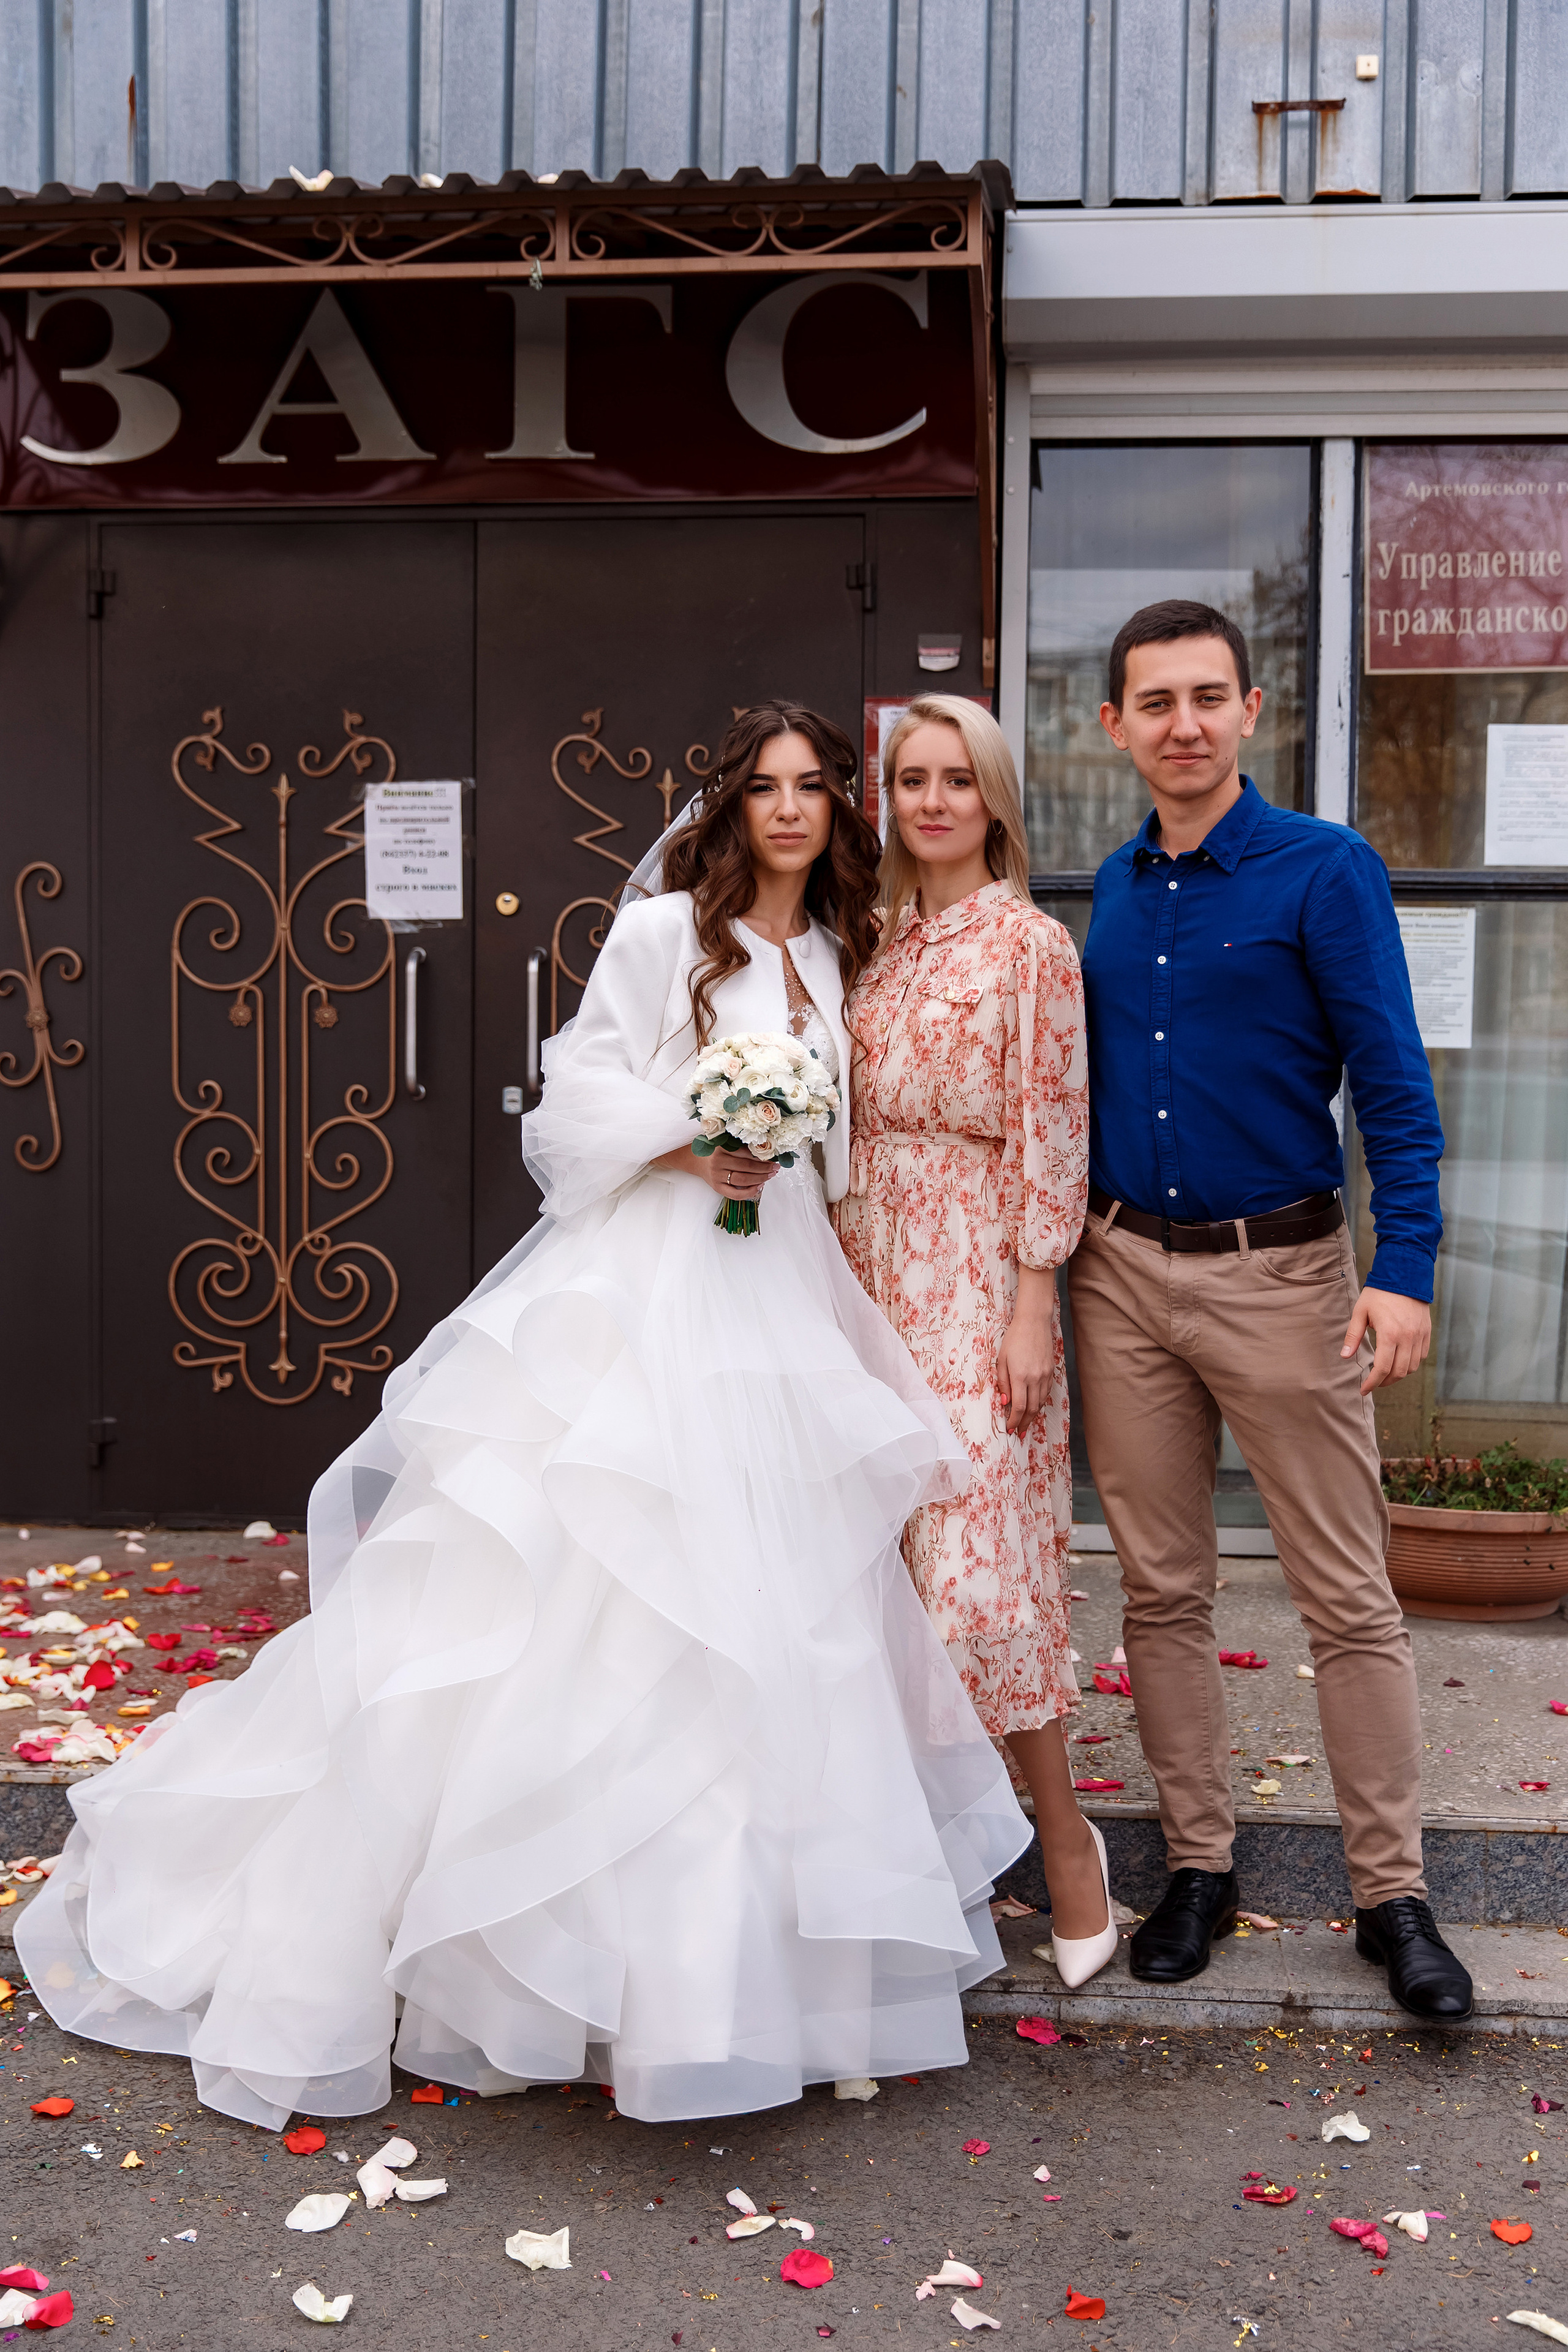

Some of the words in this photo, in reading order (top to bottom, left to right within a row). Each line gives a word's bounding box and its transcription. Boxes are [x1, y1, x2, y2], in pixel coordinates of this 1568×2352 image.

[19, 270, 929, 466] ЗАГС
[1404, 481, 1550, 502] Артемовского
[1556, 481, 1568, 495] г
[1376, 541, 1563, 591] Управление
[1377, 605, 1568, 647] гражданско
